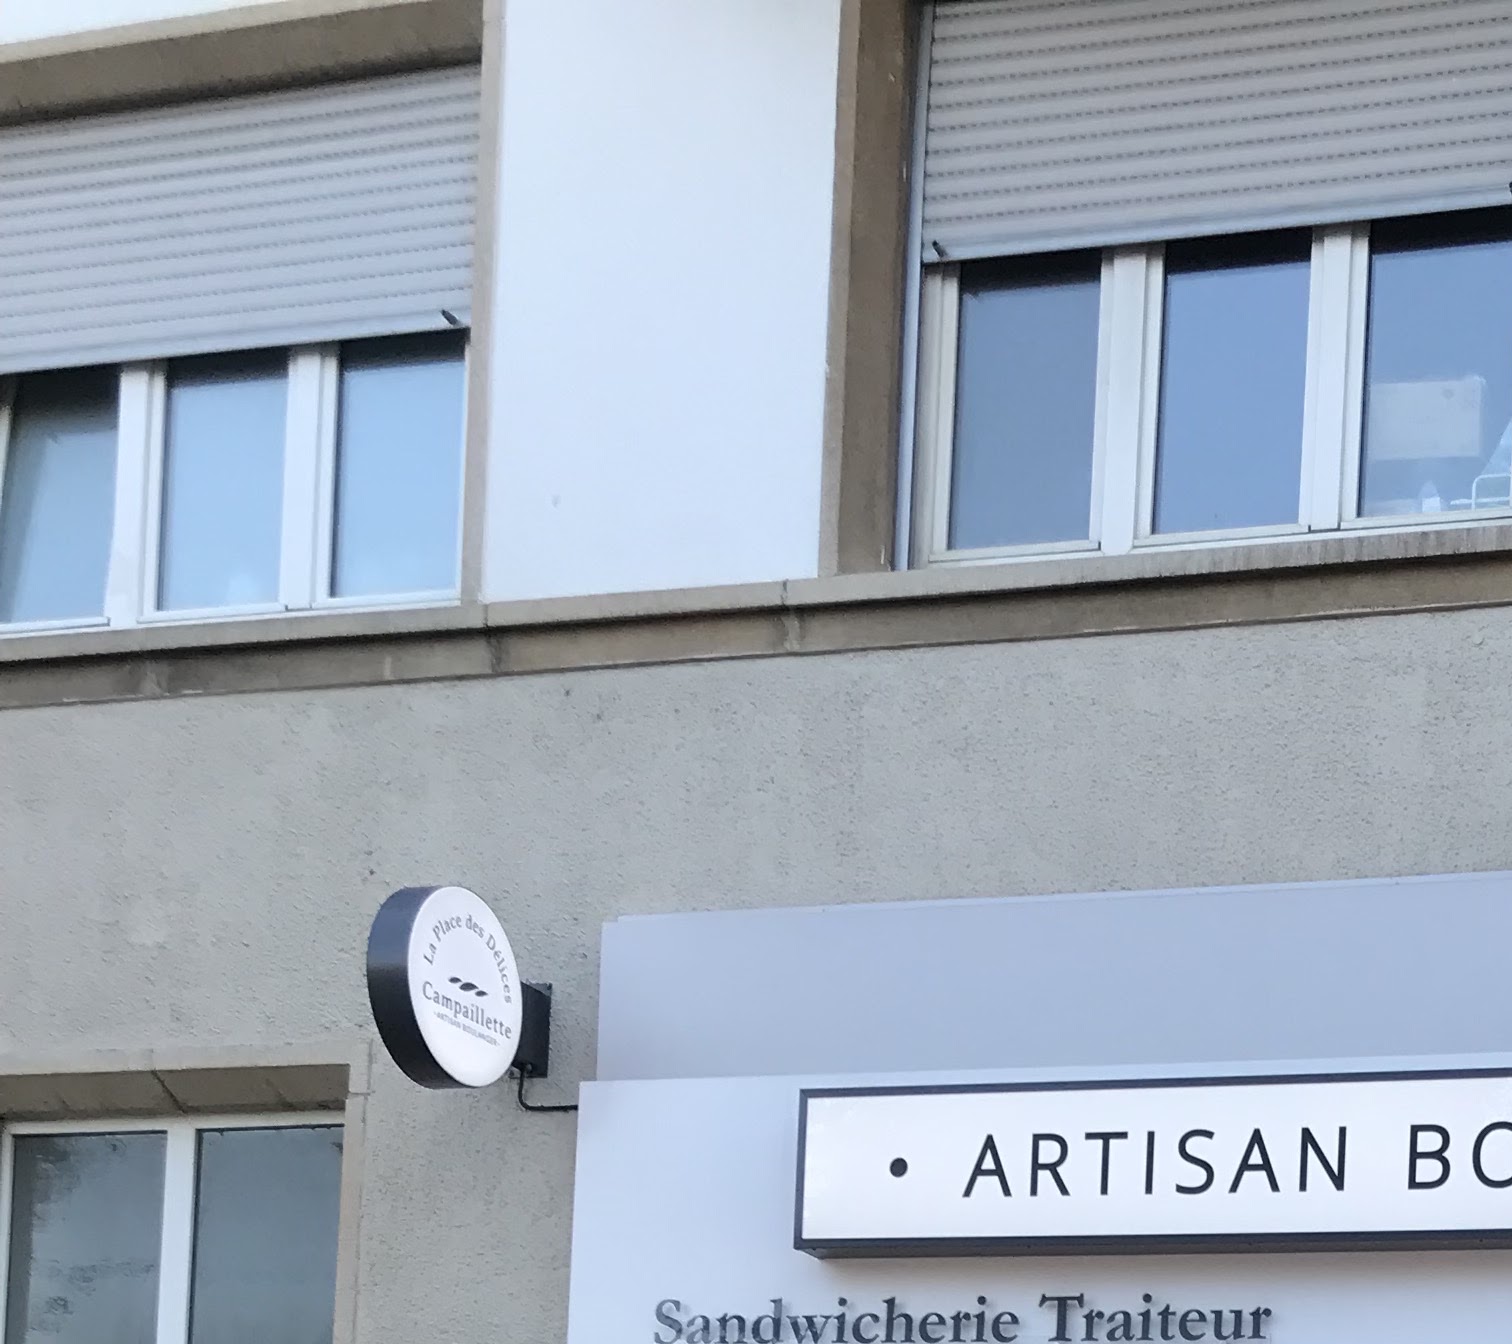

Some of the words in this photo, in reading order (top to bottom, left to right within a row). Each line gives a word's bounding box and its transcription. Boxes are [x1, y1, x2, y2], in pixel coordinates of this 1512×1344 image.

[423, 944, 437, 965] La
[432, 915, 462, 942] Place
[465, 913, 485, 939] des
[486, 934, 513, 1004] Délices
[422, 981, 512, 1039] Campaillette
[962, 1126, 1348, 1198] ARTISAN
